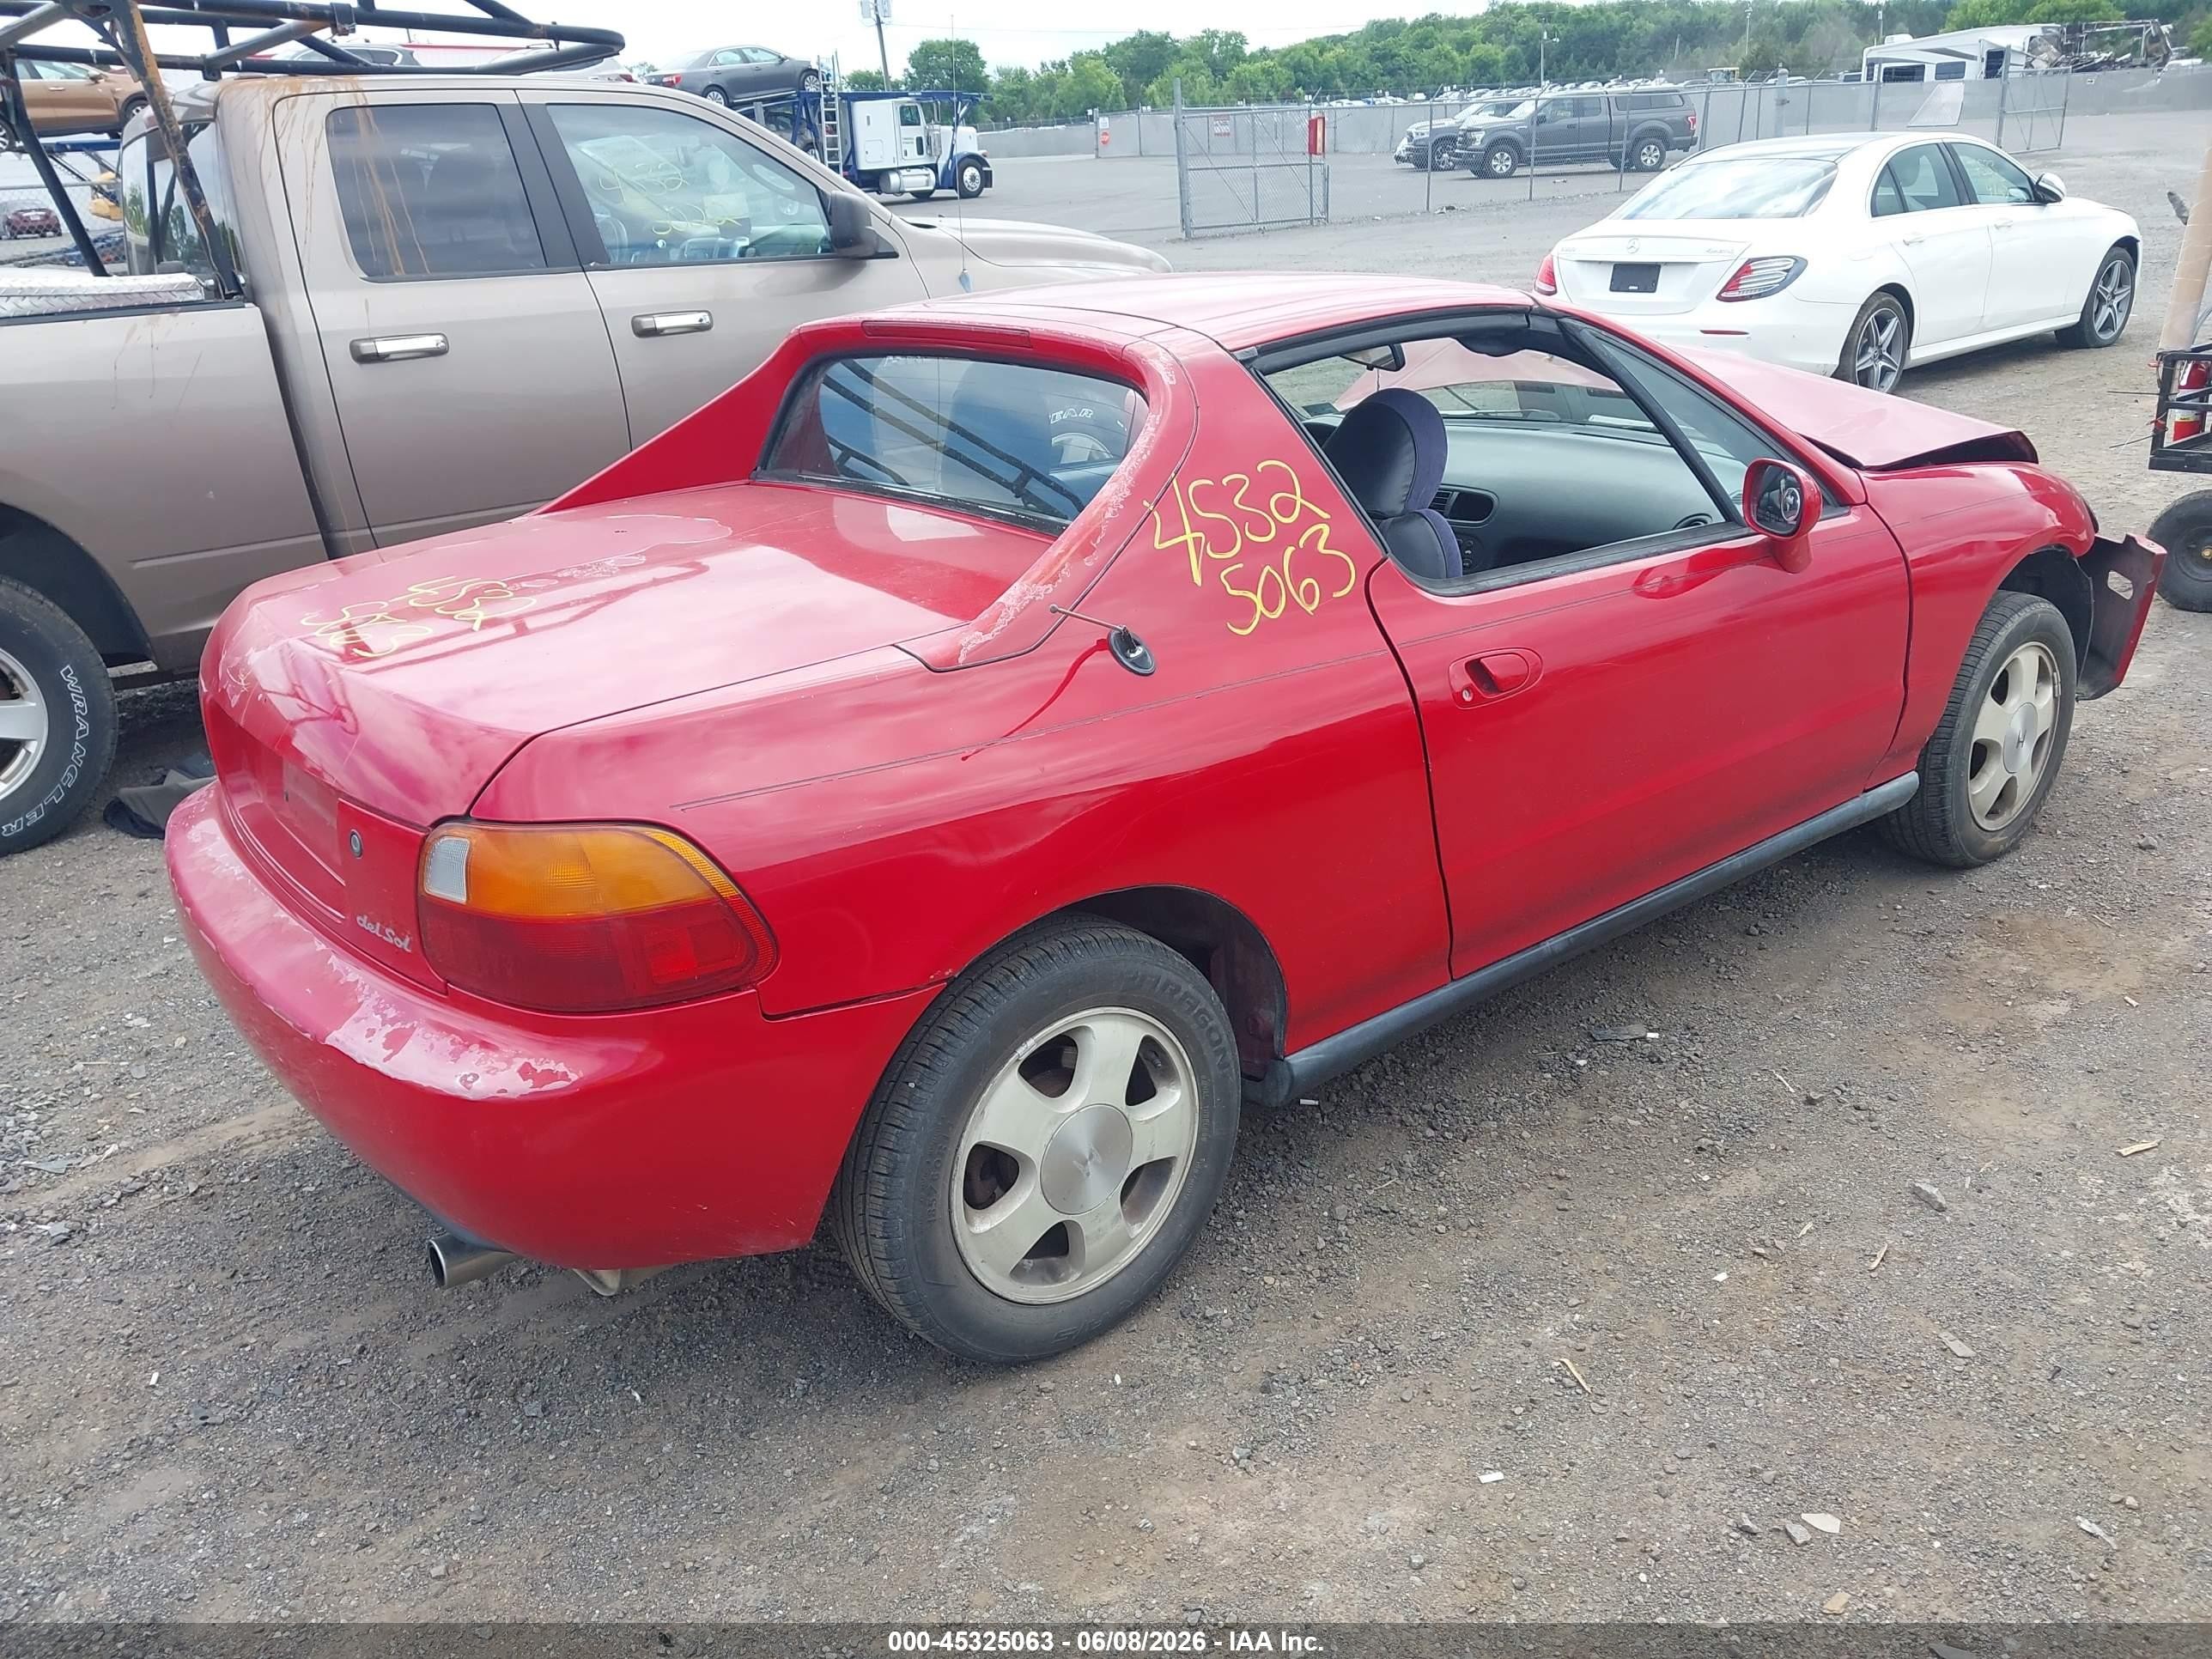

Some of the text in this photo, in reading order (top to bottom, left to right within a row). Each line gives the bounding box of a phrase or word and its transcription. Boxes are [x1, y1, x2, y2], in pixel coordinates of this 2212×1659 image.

[1143, 459, 1331, 586] 4532
[1219, 522, 1356, 635] 5063
[1, 665, 89, 837] WRANGLER
